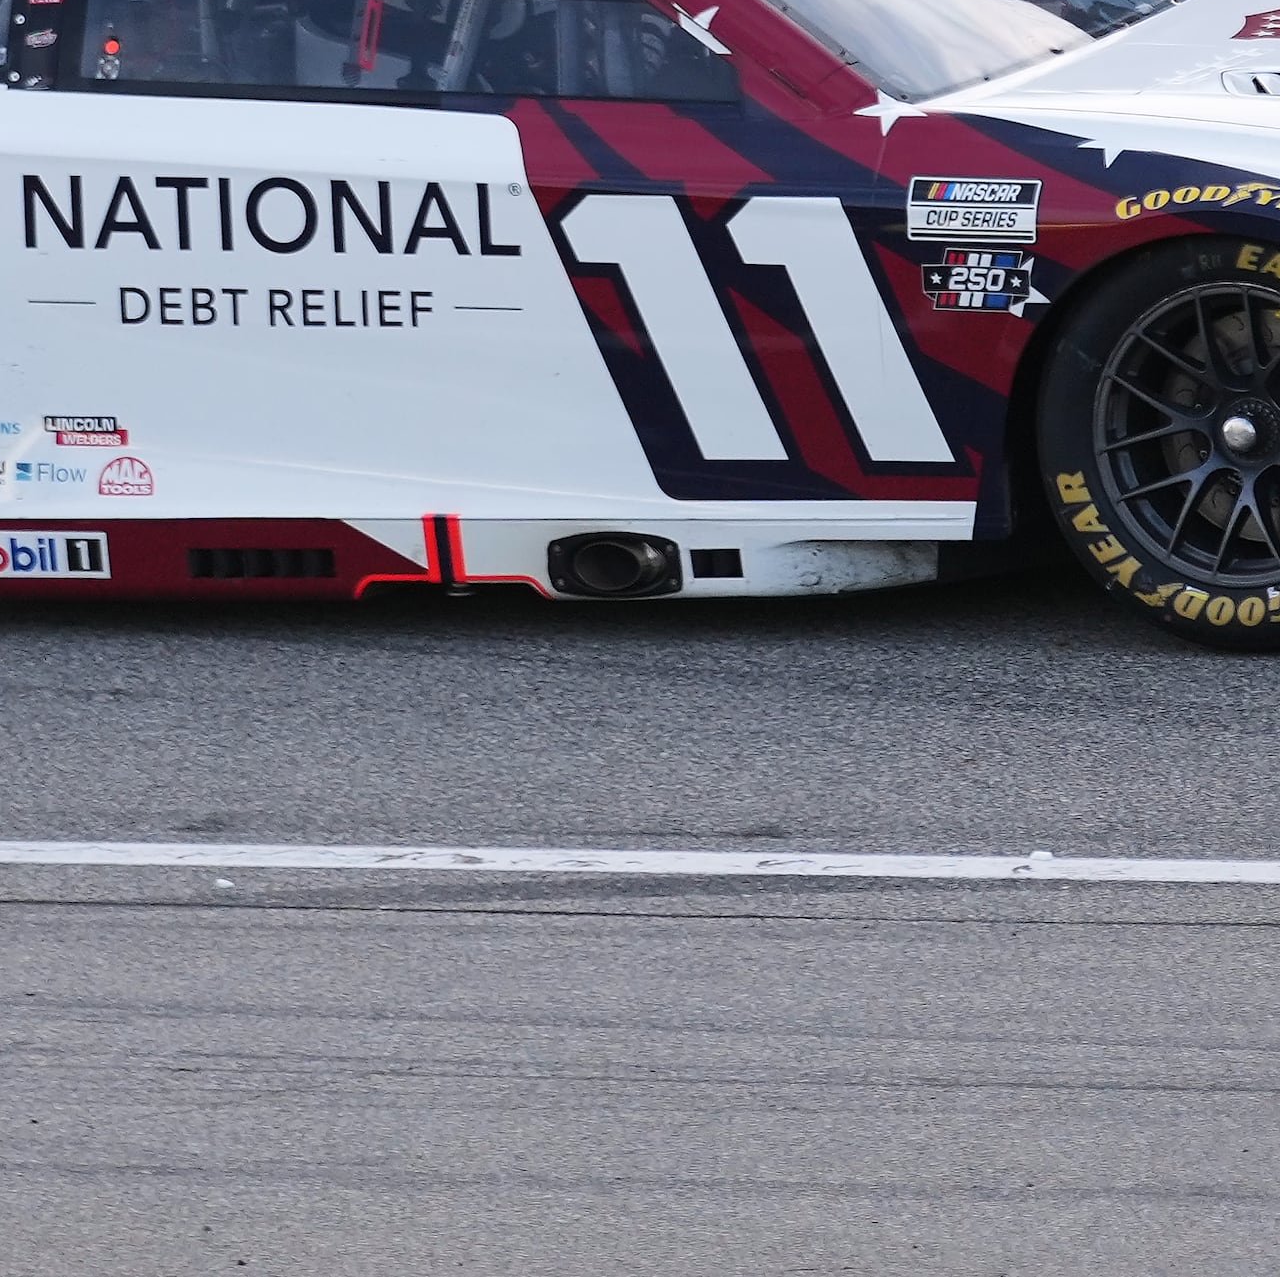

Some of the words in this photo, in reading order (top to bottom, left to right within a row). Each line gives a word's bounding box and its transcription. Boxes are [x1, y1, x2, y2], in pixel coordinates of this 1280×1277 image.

[949, 183, 1022, 202] NASCAR
[22, 174, 523, 256] NATIONAL
[926, 209, 959, 226] CUP
[961, 210, 1018, 228] SERIES
[948, 267, 1006, 292] 250
[120, 286, 250, 326] DEBT
[267, 288, 435, 329] RELIEF
[560, 194, 957, 463] 11
[45, 417, 116, 432] LINCOLN
[61, 432, 123, 446] WELDERS
[36, 462, 88, 484] Flow
[101, 459, 152, 484] MAC
[101, 484, 152, 495] TOOLS
